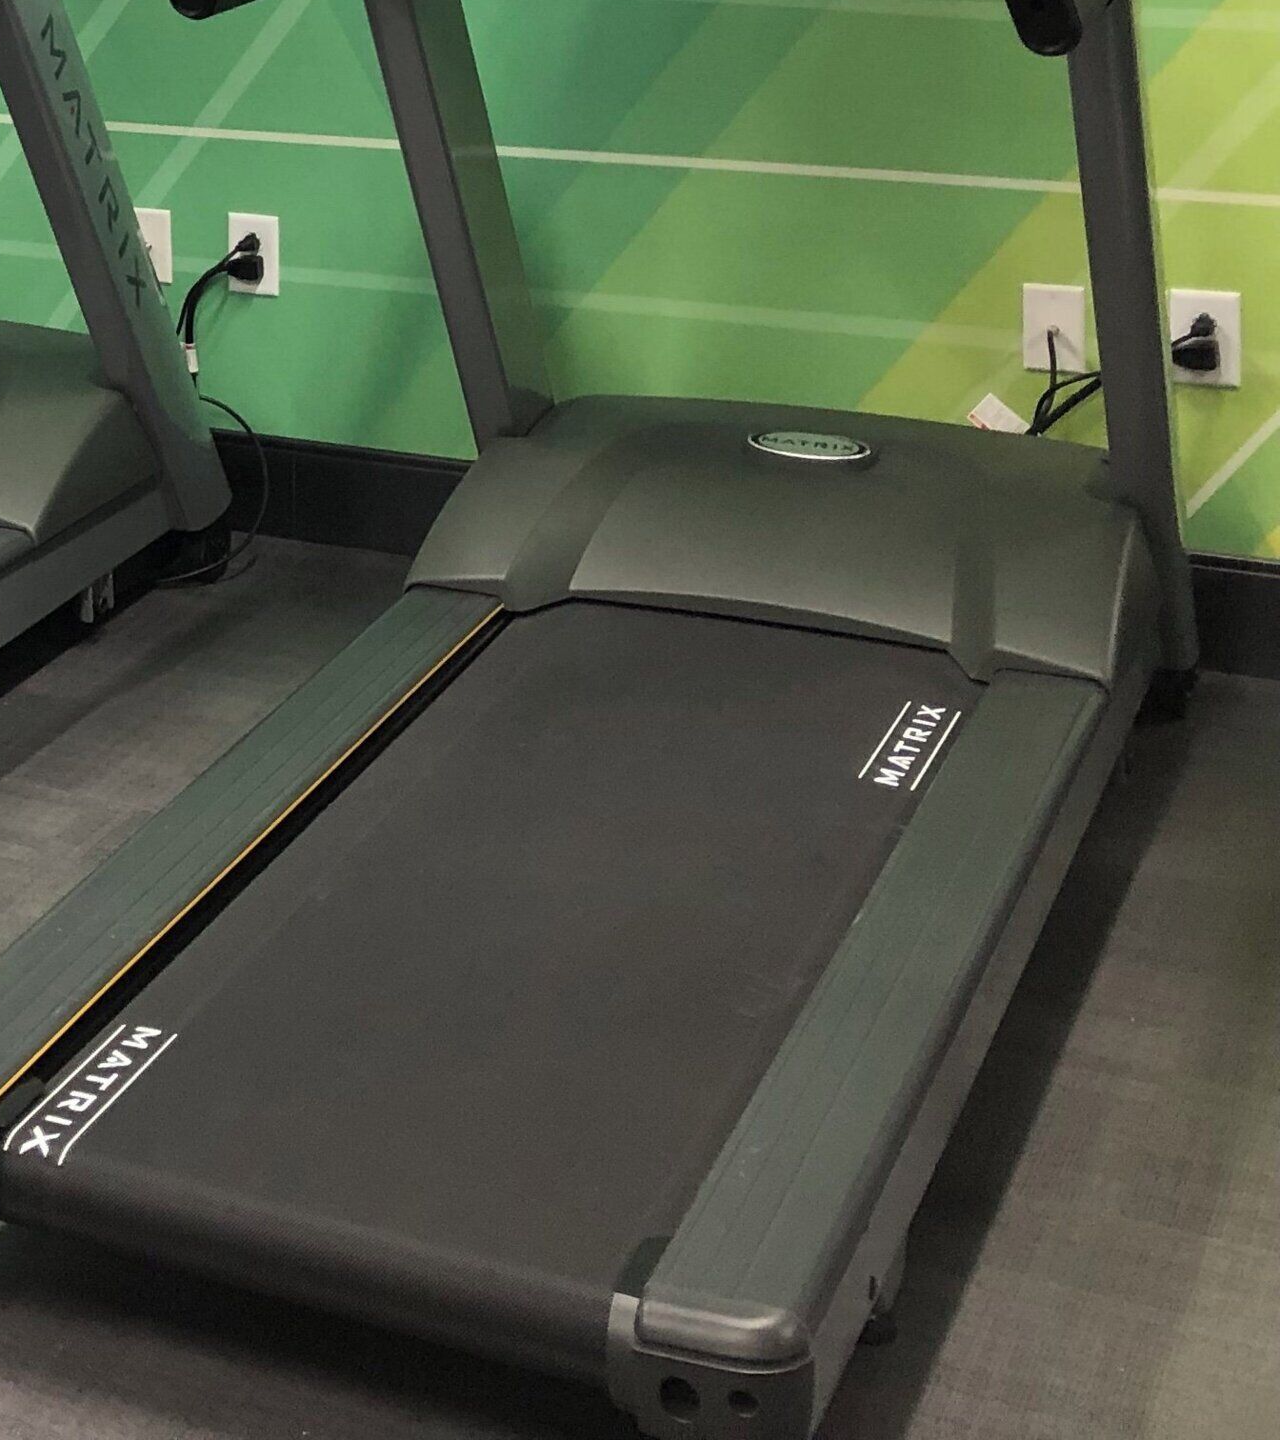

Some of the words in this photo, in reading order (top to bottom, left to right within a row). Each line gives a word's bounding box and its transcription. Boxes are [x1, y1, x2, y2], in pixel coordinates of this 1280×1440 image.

[41, 12, 148, 308] MATRIX
[762, 436, 853, 451] MATRIX
[873, 704, 947, 787] MATRIX
[19, 1026, 162, 1158] MATRIX
